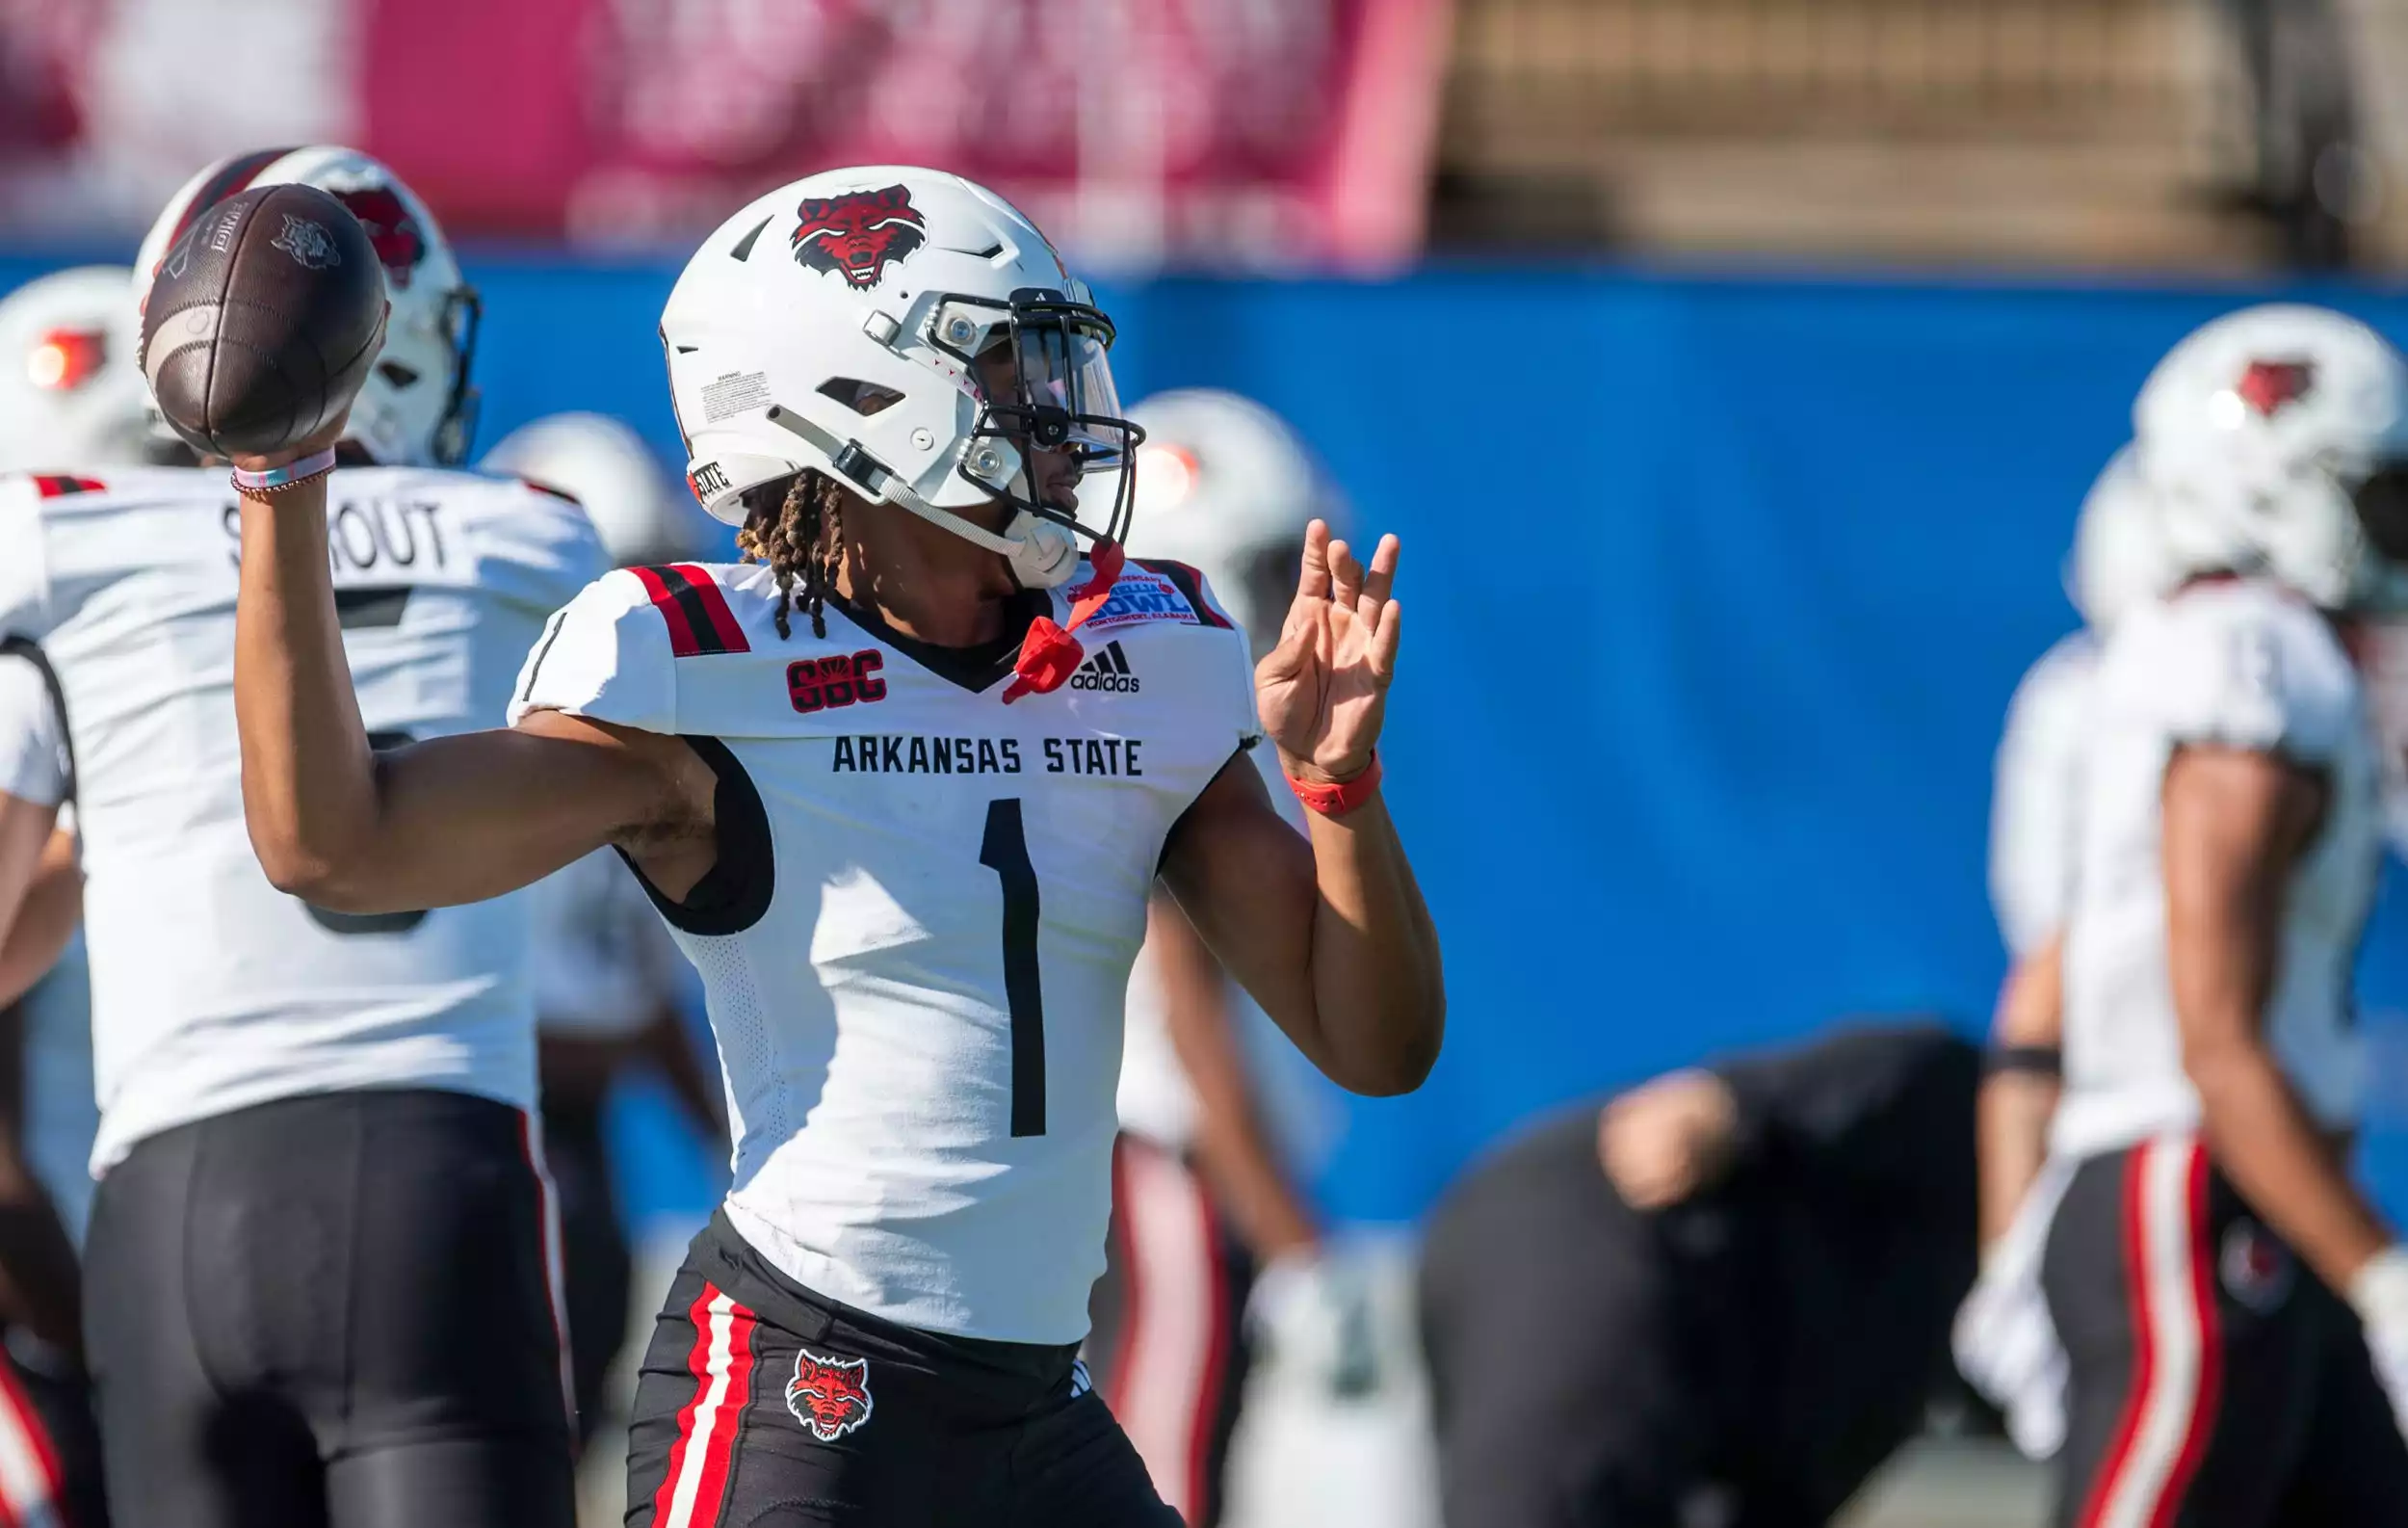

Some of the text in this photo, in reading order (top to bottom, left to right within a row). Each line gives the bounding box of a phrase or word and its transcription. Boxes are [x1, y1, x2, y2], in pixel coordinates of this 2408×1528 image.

[222, 499, 447, 571] SOUT
[787, 648, 887, 713] SBC
[1070, 672, 1140, 693] adidas
[832, 735, 1142, 776] ARKANSAS STATE
[979, 798, 1047, 1138] 1
